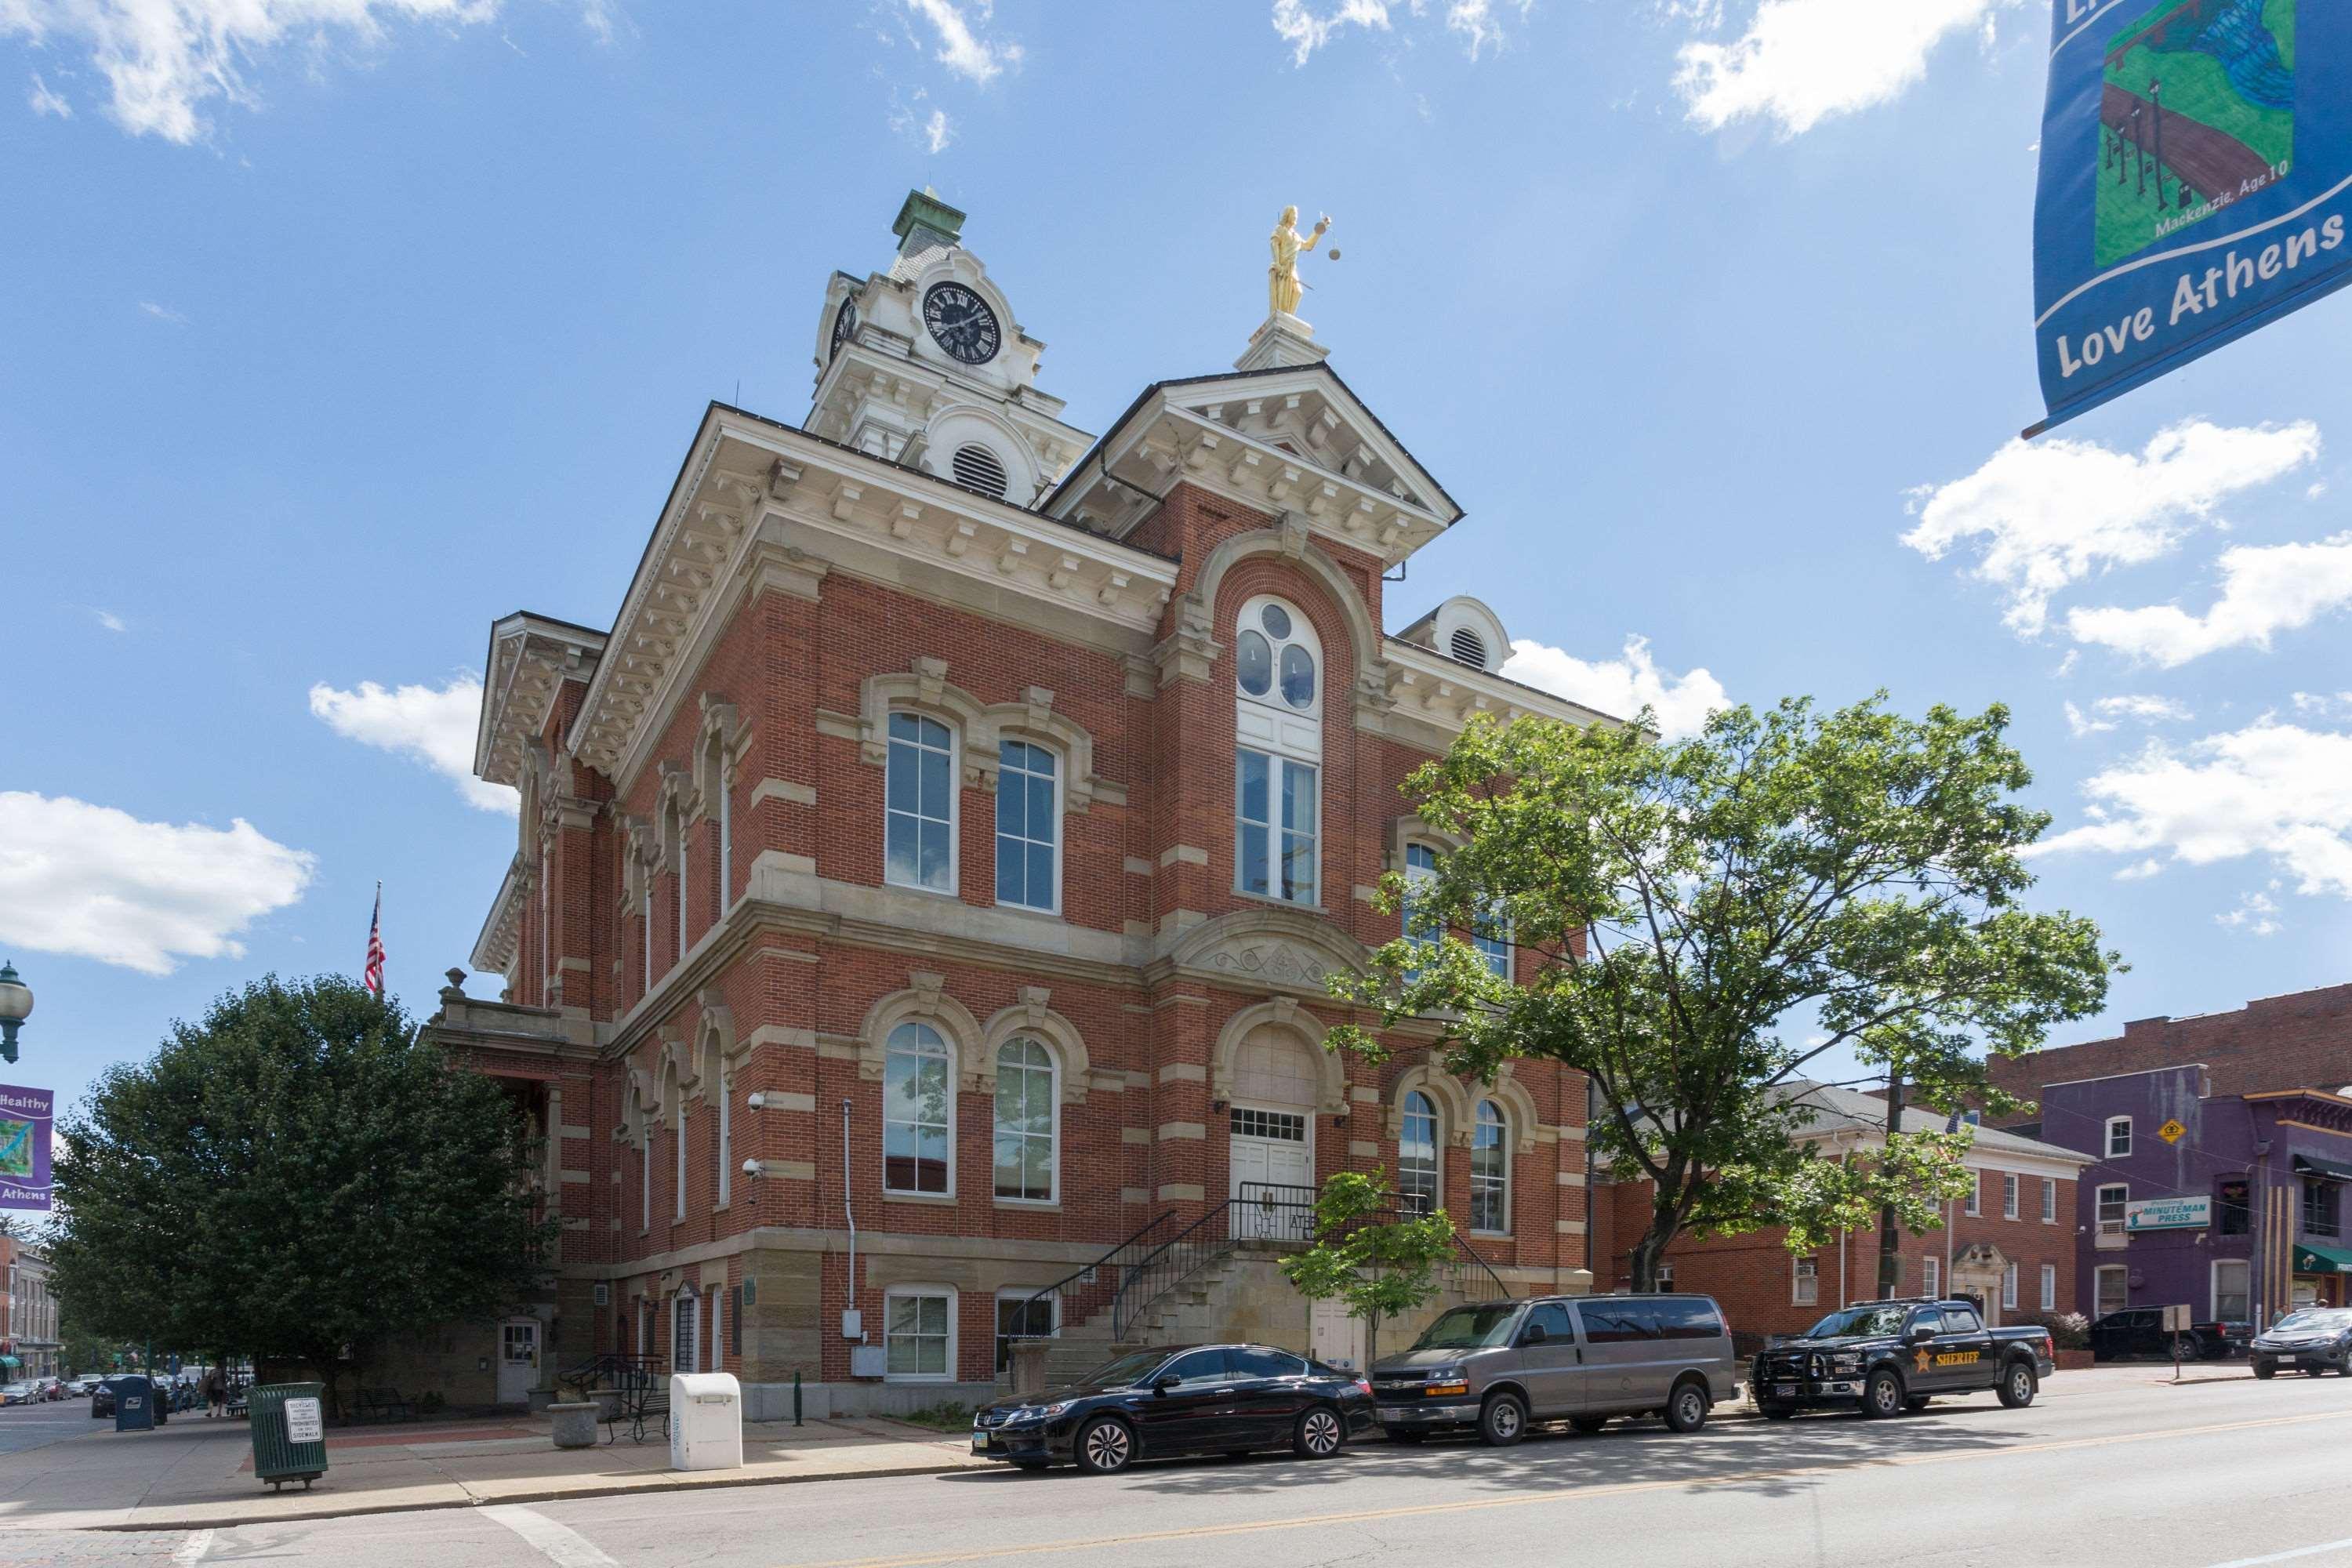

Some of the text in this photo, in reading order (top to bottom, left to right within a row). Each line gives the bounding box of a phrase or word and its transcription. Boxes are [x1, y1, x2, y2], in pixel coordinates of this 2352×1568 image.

[2156, 191, 2235, 237] Mackenzie,
[2238, 174, 2267, 196] Age
[2056, 214, 2345, 378] Love Athens
[0, 1094, 49, 1111] Healthy
[2, 1188, 46, 1200] Athens
[2143, 1203, 2206, 1215] MINUTEMAN
[2158, 1214, 2190, 1222] PRESS
[1936, 1351, 1980, 1366] SHERIFF
